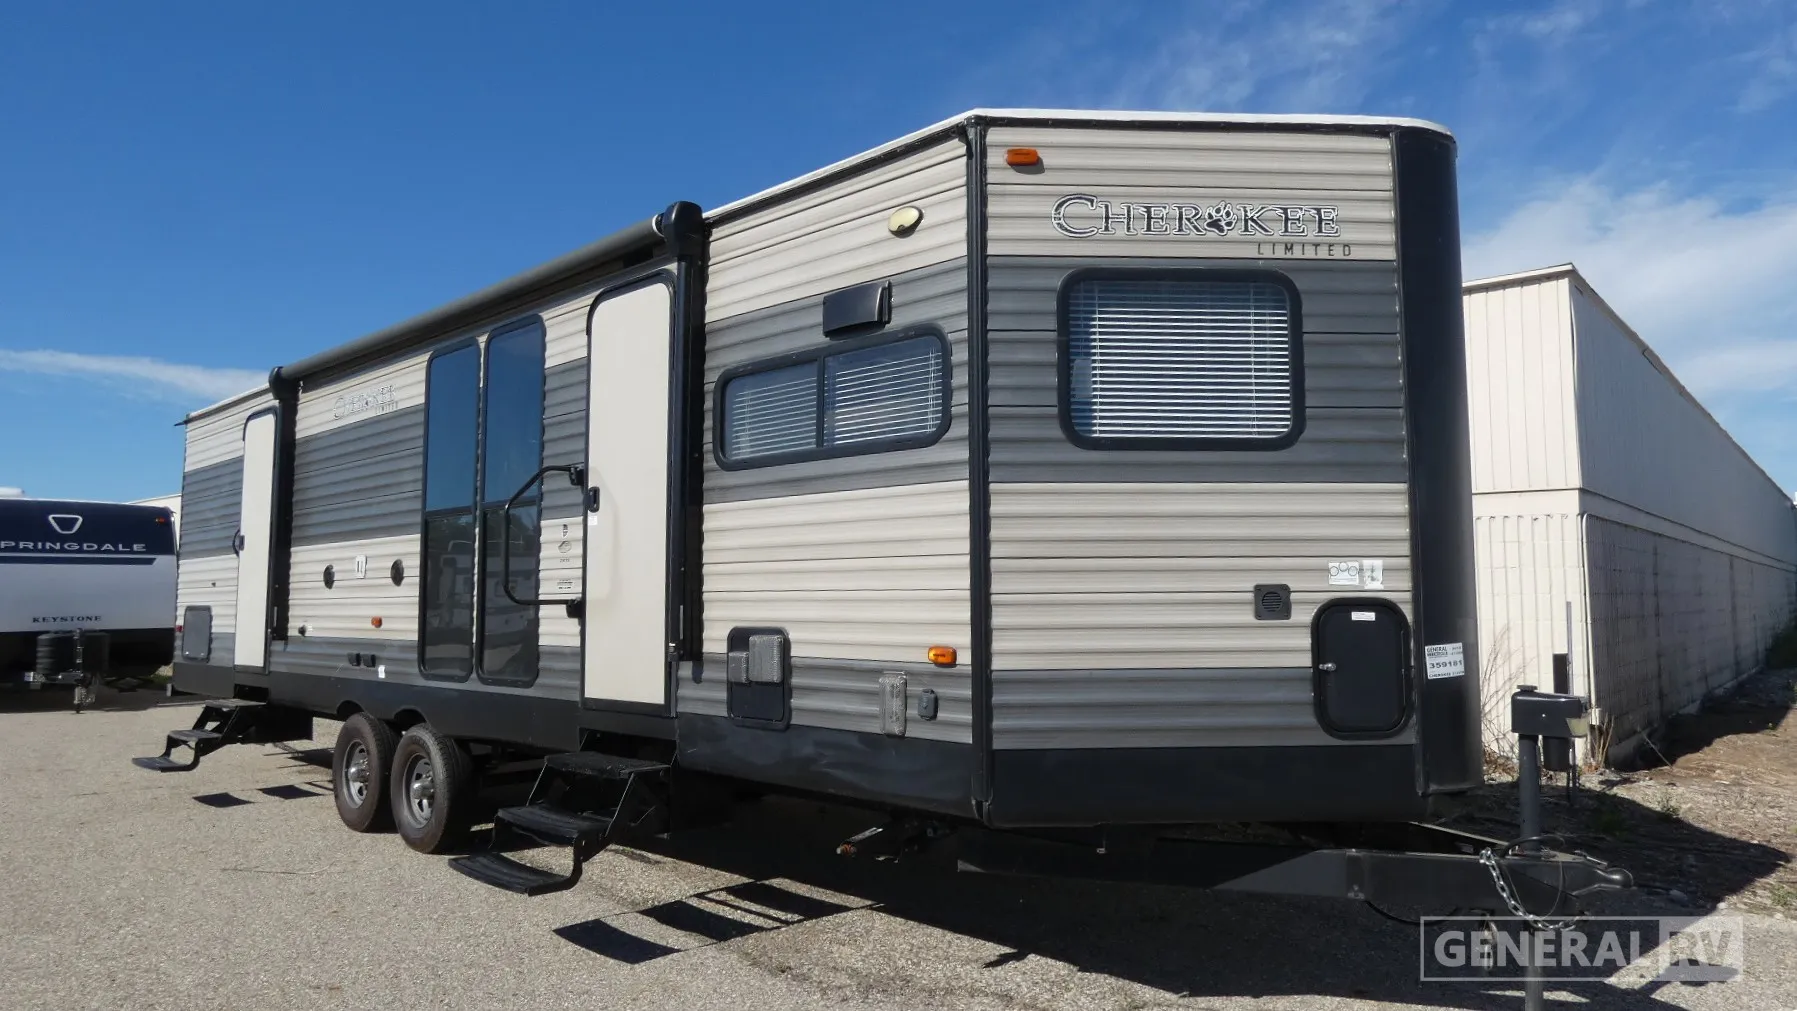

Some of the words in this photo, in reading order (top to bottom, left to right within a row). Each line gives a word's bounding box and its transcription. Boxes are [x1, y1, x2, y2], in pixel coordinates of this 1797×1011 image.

[1257, 242, 1352, 257] LIMITED
[0, 540, 147, 552] PRINGDALE
[32, 615, 102, 624] KEYSTONE
[1429, 660, 1463, 669] 359181
